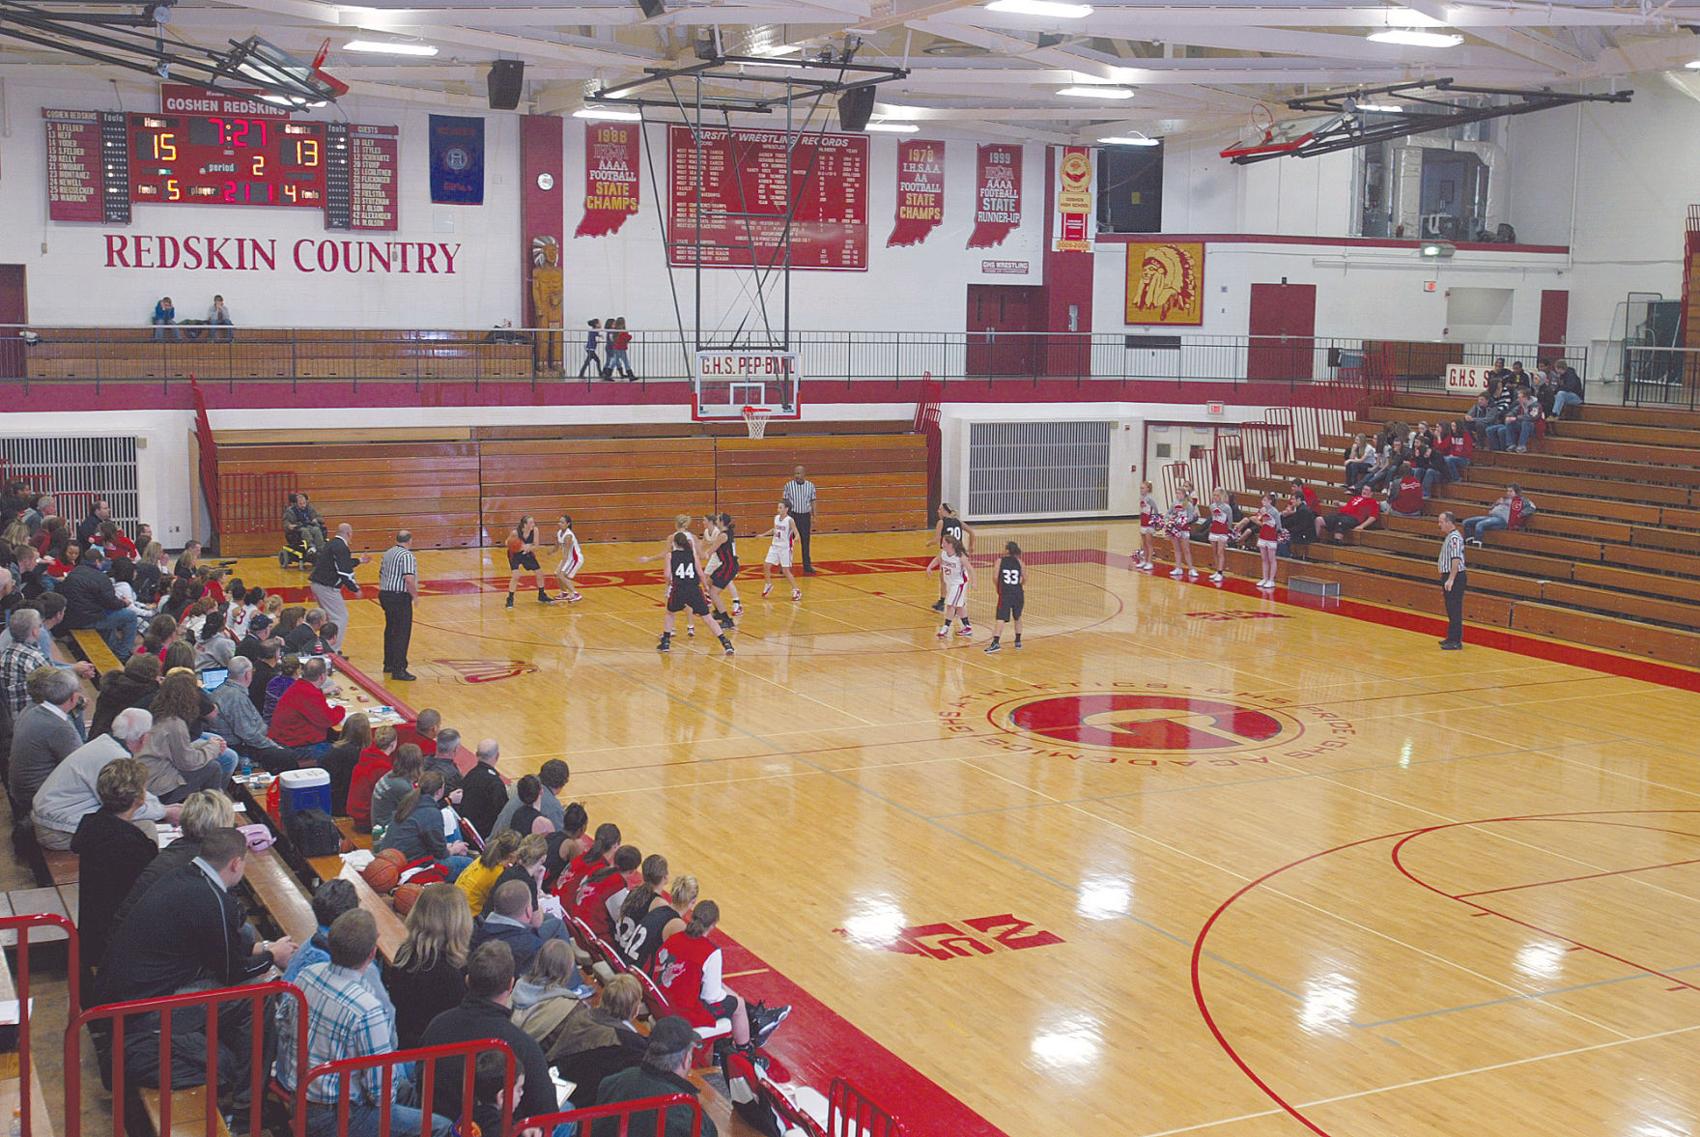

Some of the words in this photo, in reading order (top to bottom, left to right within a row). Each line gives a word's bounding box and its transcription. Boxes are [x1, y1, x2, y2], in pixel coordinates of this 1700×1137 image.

[167, 98, 218, 112] GOSHEN
[224, 101, 286, 115] REDSKINS
[208, 117, 267, 147] 7:27
[598, 128, 628, 144] 1988
[153, 133, 177, 161] 15
[739, 133, 797, 145] WRESTLING
[801, 136, 849, 147] RECORDS
[296, 139, 318, 166] 13
[989, 152, 1011, 164] 1999
[208, 163, 234, 173] period
[252, 156, 265, 176] 2
[599, 161, 629, 171] AAAA
[589, 170, 637, 182] FOOTBALL
[914, 173, 928, 182] AA
[167, 179, 180, 200] 5
[595, 181, 629, 196] STATE
[900, 181, 941, 192] FOOTBALL
[986, 179, 1012, 189] AAAA
[284, 184, 297, 203] 4
[906, 192, 935, 206] STATE
[980, 188, 1019, 198] FOOTBALL
[587, 195, 638, 211] CHAMPS
[983, 198, 1015, 211] STATE
[900, 206, 941, 220] CHAMPS
[978, 211, 1020, 223] RUNNER-UP
[103, 234, 277, 271] REDSKIN
[293, 239, 461, 274] COUNTRY
[1449, 368, 1478, 387] G.H.S.
[675, 562, 695, 579] 44
[1002, 569, 1019, 585] 33
[1296, 705, 1356, 735] PRIDE
